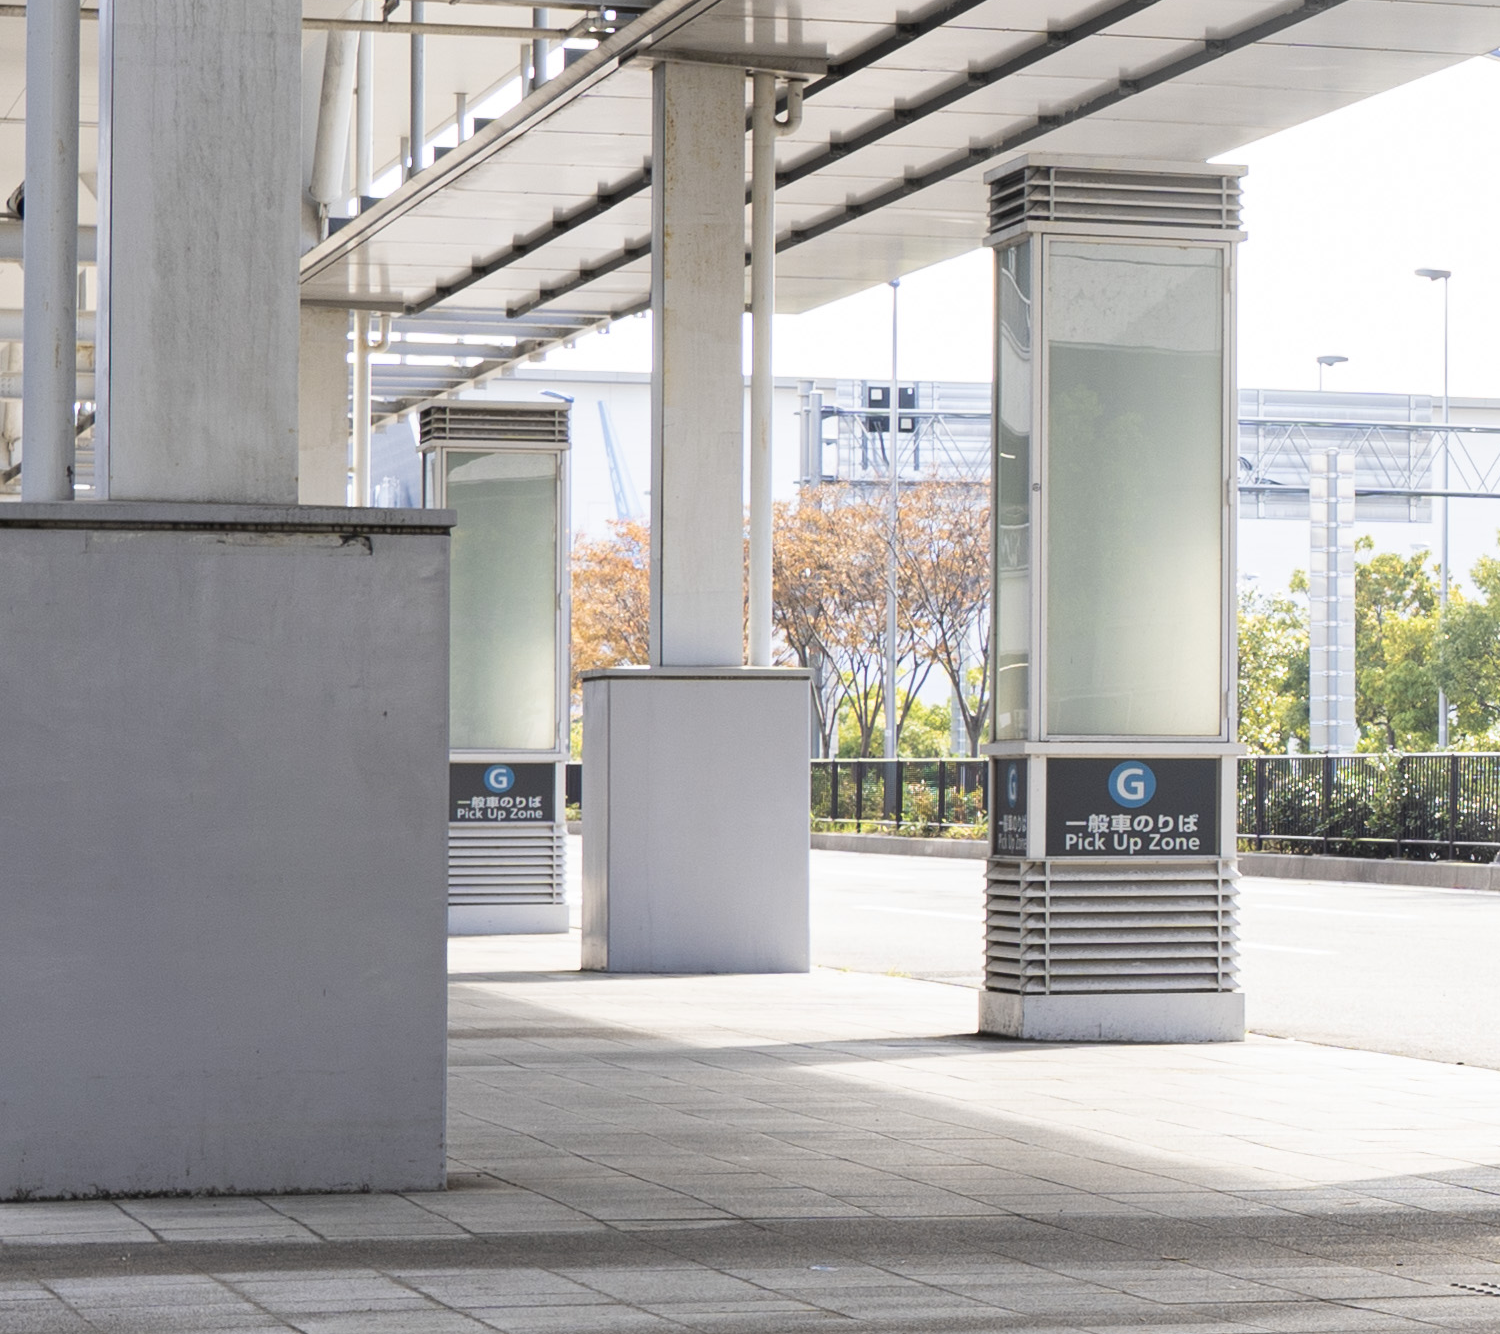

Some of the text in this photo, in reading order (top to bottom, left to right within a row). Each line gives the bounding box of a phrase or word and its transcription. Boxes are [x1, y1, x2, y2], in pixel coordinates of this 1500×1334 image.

[489, 769, 507, 789] G
[1009, 768, 1016, 801] G
[1117, 768, 1145, 800] G
[457, 796, 542, 808] 一般車のりば
[457, 808, 543, 821] Pick Up Zone
[1065, 814, 1199, 833] 一般車のりば
[1065, 833, 1201, 855] Pick Up Zone
